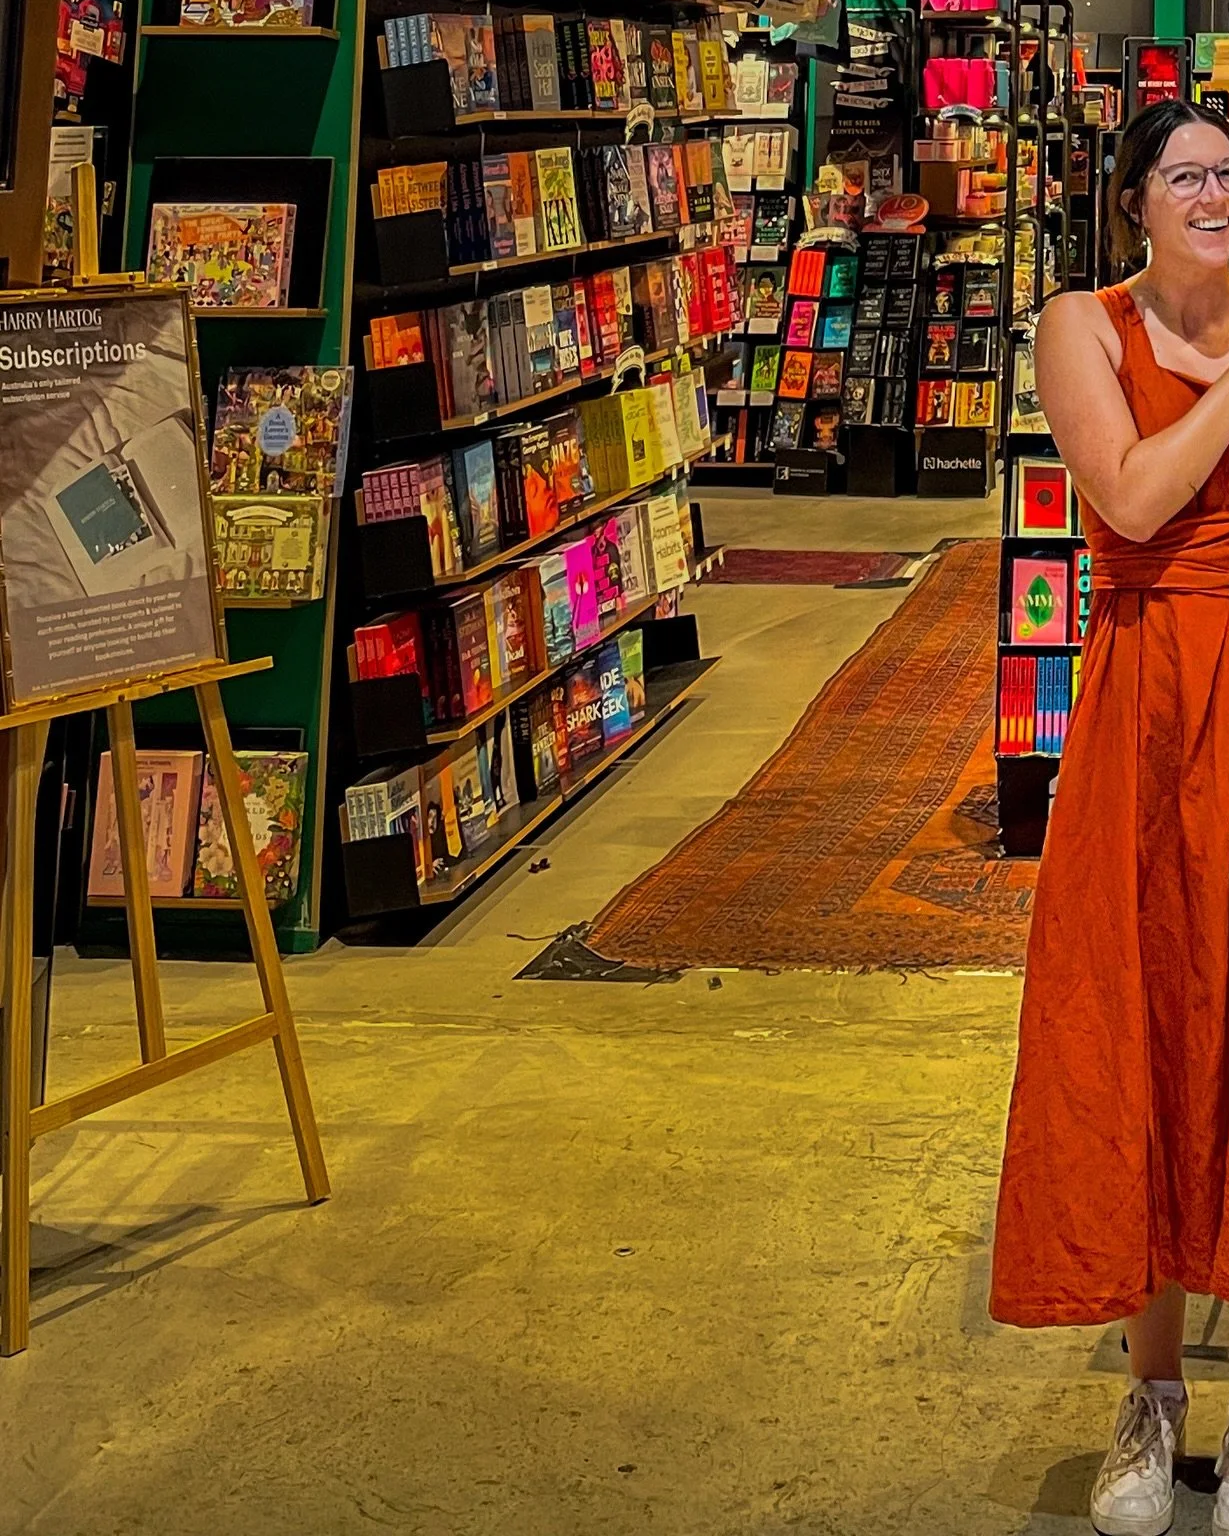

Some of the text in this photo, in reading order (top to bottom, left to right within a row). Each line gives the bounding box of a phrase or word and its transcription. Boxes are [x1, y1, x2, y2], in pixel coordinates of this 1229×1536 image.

[407, 179, 446, 193] BETWEEN
[410, 196, 446, 212] SISTERS
[543, 198, 577, 246] KIN
[0, 308, 102, 331] HARRY HARTOG
[0, 340, 147, 370] Subscriptions
[551, 438, 579, 470] HAZE
[937, 458, 982, 470] hachette
[1017, 595, 1063, 608] AMMA
[1076, 553, 1091, 638] HOLY
[600, 667, 621, 691] IDE
[566, 701, 601, 732] SHARK
[602, 694, 626, 720] EEK
